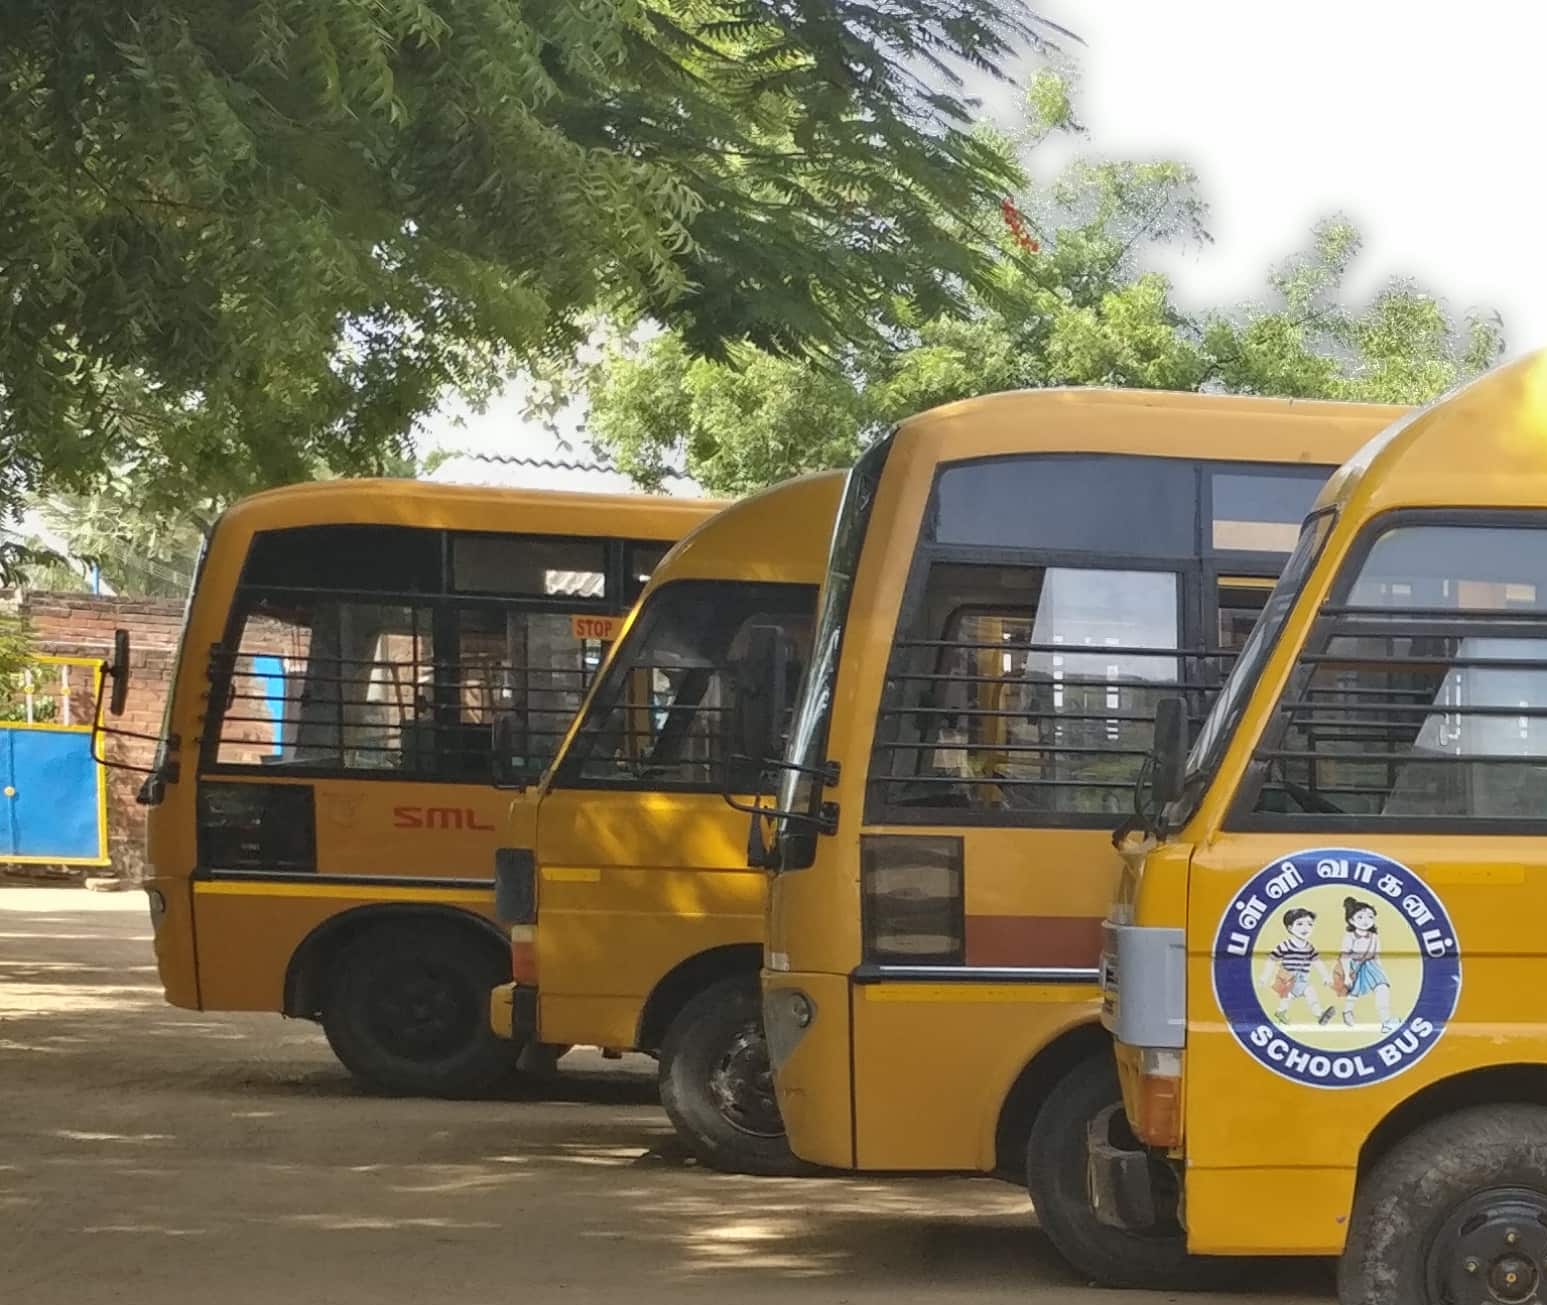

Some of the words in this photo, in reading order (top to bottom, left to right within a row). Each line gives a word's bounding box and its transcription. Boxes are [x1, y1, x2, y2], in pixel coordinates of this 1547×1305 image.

[576, 618, 613, 637] STOP
[1250, 1025, 1375, 1079] SCHOOL
[1377, 1016, 1434, 1067] BUS
